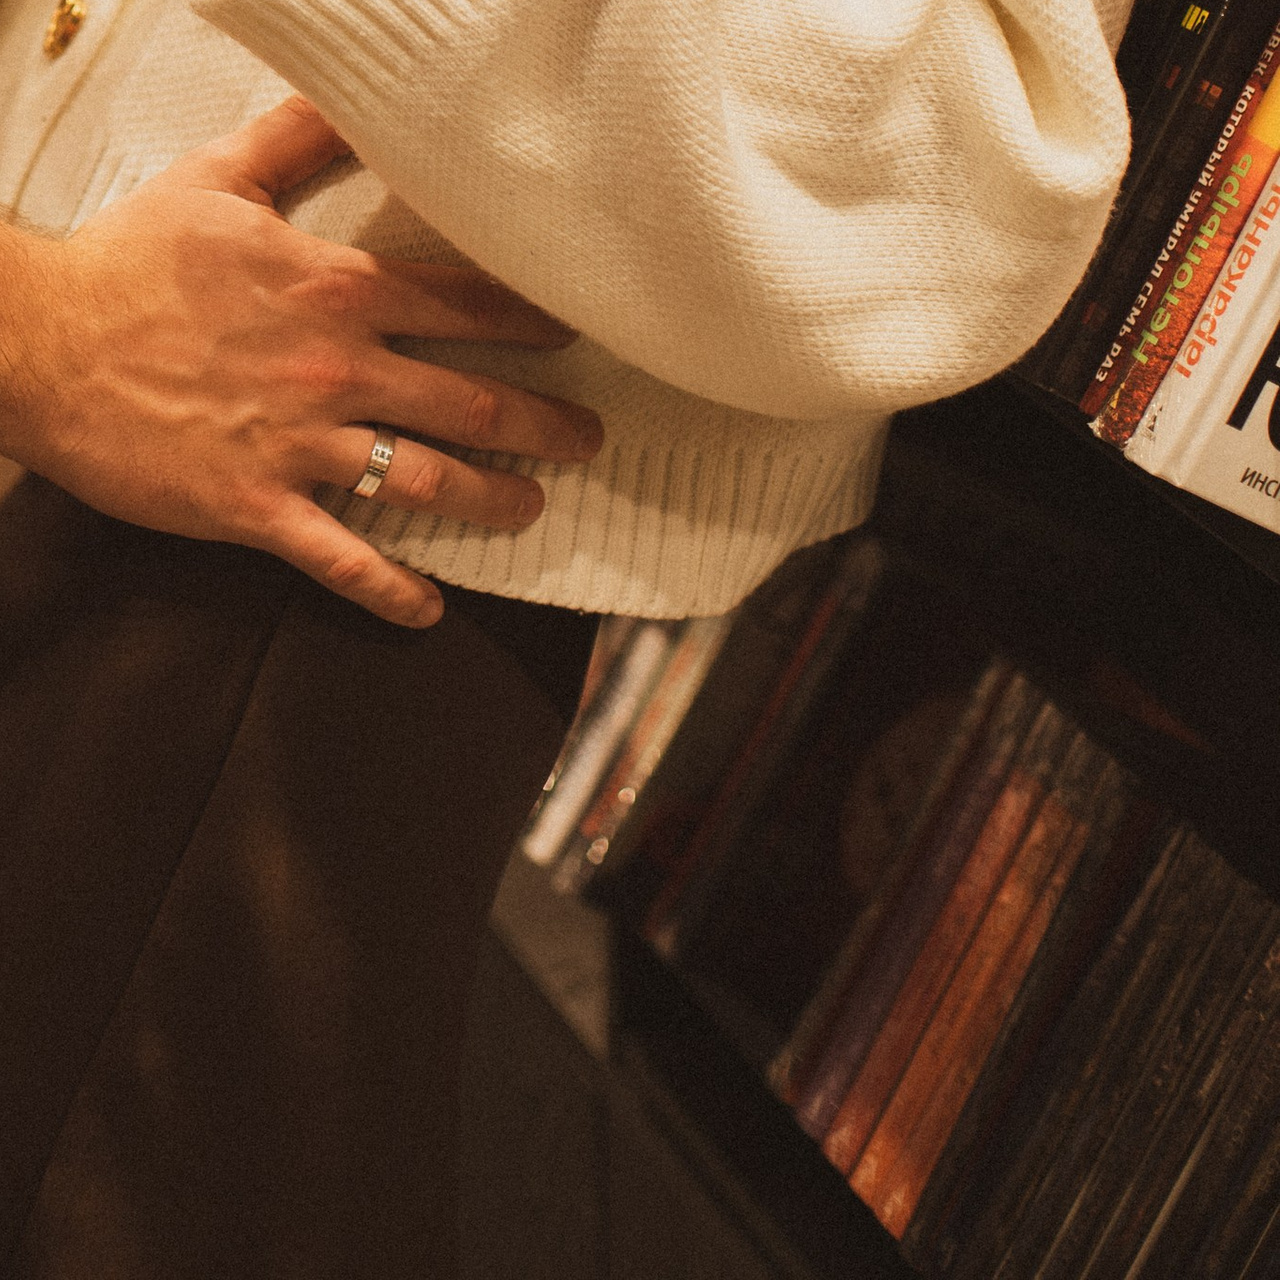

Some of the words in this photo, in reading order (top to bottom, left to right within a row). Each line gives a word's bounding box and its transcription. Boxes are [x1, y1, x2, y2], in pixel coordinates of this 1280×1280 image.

[1197, 84, 1256, 188] КОТОРЫЙ
[1132, 152, 1254, 366] Нетопырь
[1149, 189, 1203, 278] УМИРАЛ
[1117, 279, 1154, 340] СЕМЬ
[1094, 341, 1123, 383] РАЗ
